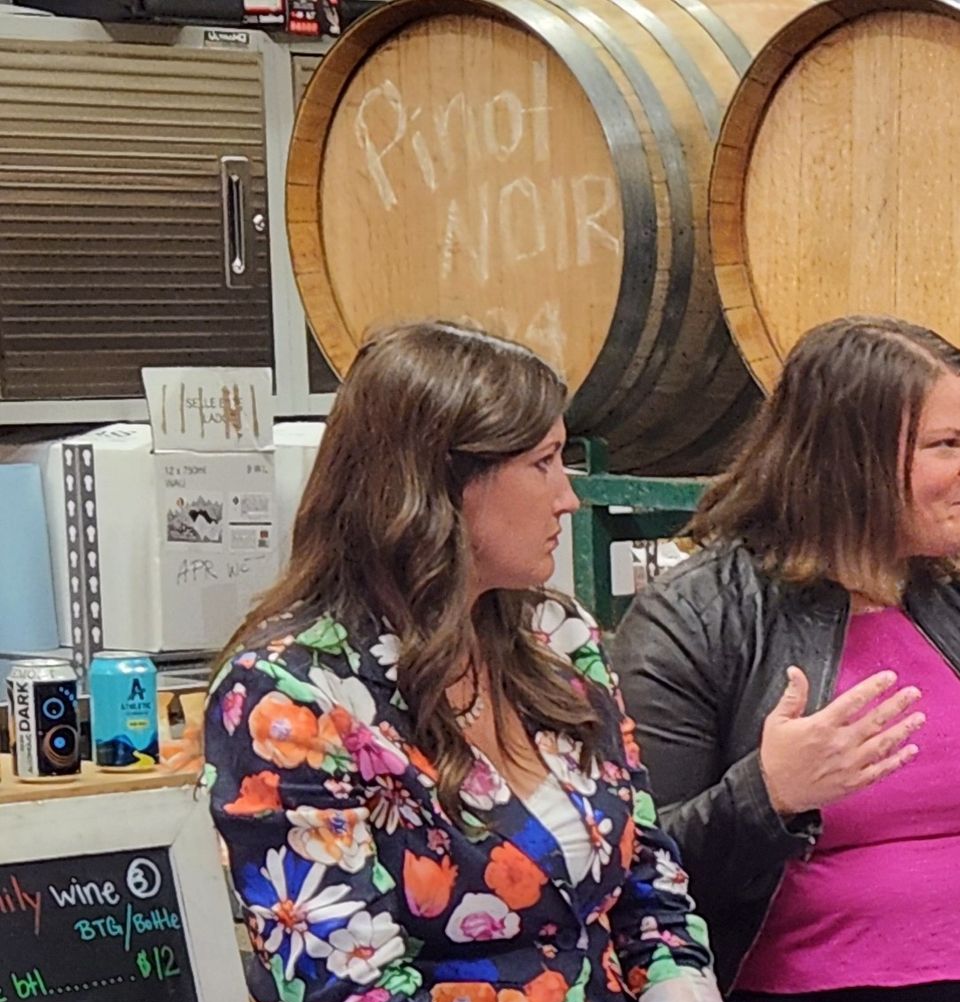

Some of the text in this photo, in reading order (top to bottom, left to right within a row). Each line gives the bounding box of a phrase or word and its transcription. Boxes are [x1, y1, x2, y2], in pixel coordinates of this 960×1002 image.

[353, 58, 553, 211] Pinot
[440, 174, 621, 284] NOIR
[17, 681, 32, 732] DARK
[136, 945, 181, 980] $12
